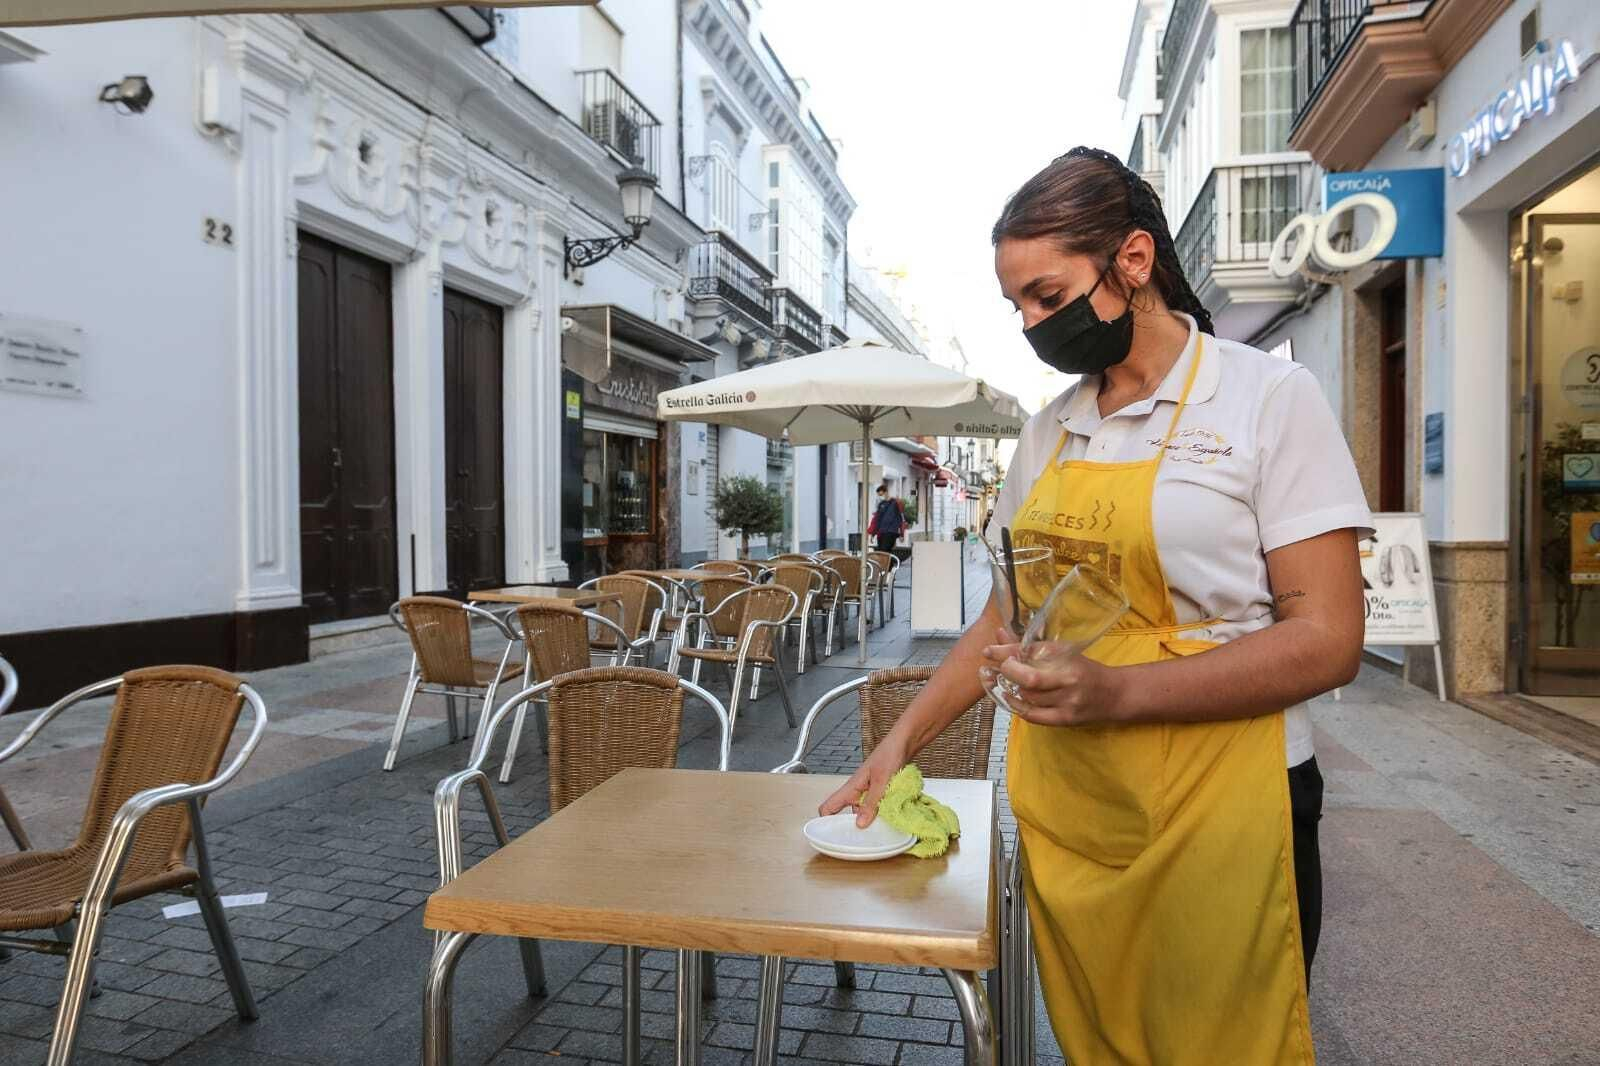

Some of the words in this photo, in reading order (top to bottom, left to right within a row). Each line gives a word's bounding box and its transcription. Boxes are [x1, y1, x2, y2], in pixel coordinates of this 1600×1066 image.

[205, 217, 233, 245] 22
[666, 396, 704, 408] Estrella
[706, 391, 743, 406] Galicia
